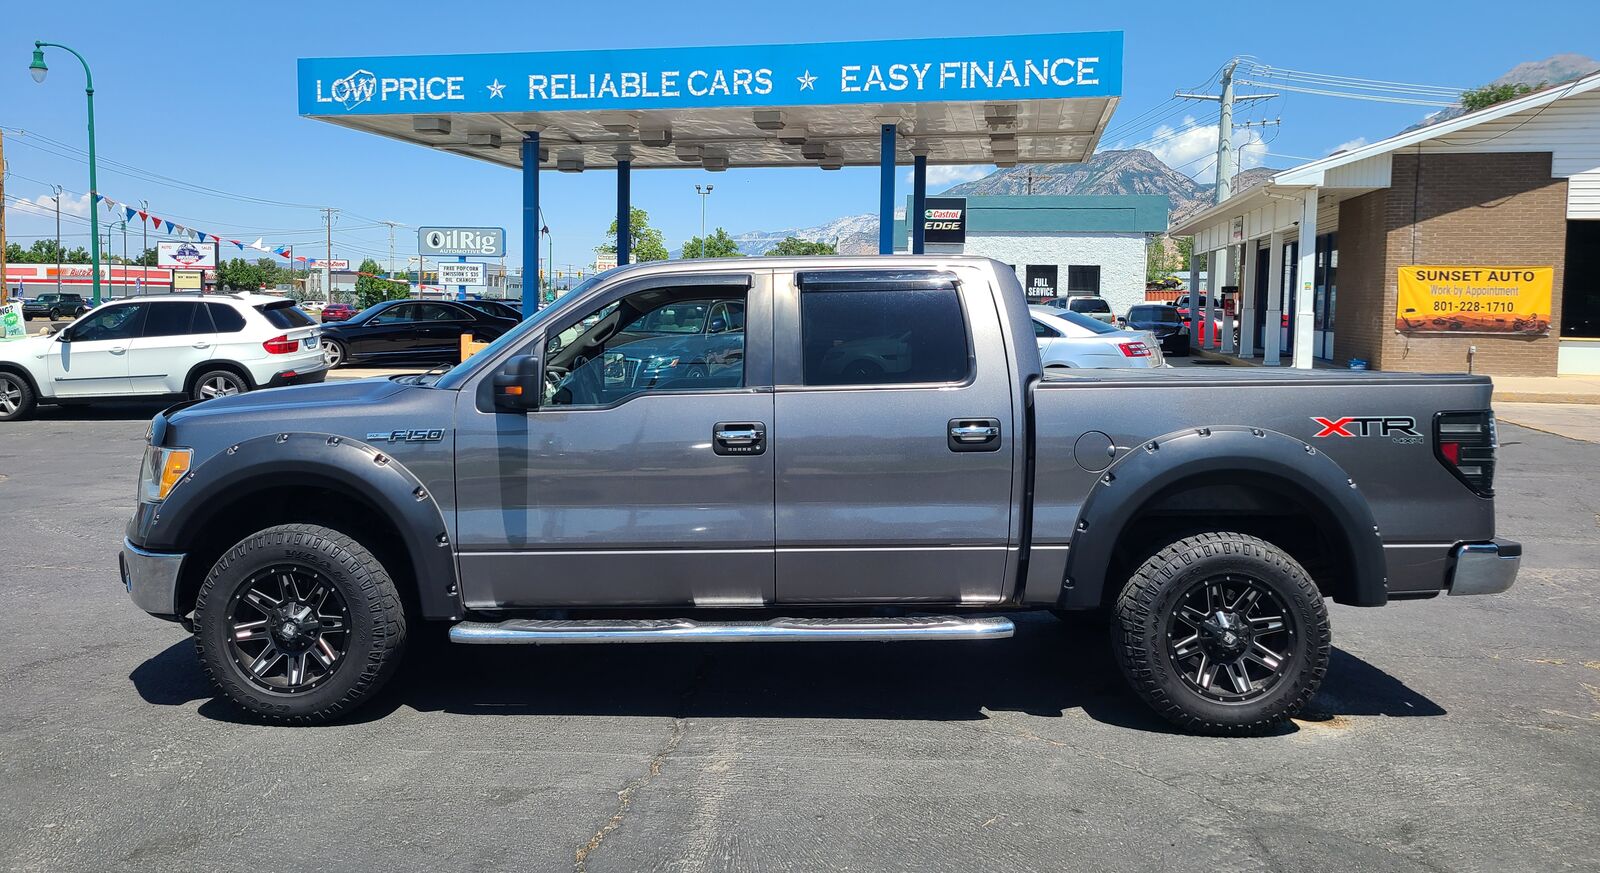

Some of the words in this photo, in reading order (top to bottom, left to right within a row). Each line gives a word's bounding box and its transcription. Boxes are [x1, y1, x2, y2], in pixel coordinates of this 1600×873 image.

[317, 77, 374, 102] LOW
[382, 77, 464, 100] PRICE
[528, 71, 680, 99] RELIABLE
[687, 69, 773, 96] CARS
[841, 63, 932, 92] EASY
[939, 57, 1099, 89] FINANCE
[925, 222, 961, 230] EDGE
[426, 230, 496, 254] OilRig
[69, 268, 106, 277] AutoZe
[1416, 270, 1482, 281] SUNSET
[1487, 271, 1535, 282] AUTO
[1034, 278, 1048, 286] FULL
[1028, 287, 1054, 296] SERVICE
[1430, 285, 1451, 295] Work
[1453, 285, 1463, 297] by
[1465, 286, 1519, 298] Appointment
[1433, 301, 1514, 312] 801-228-1710
[1309, 416, 1424, 438] XTR
